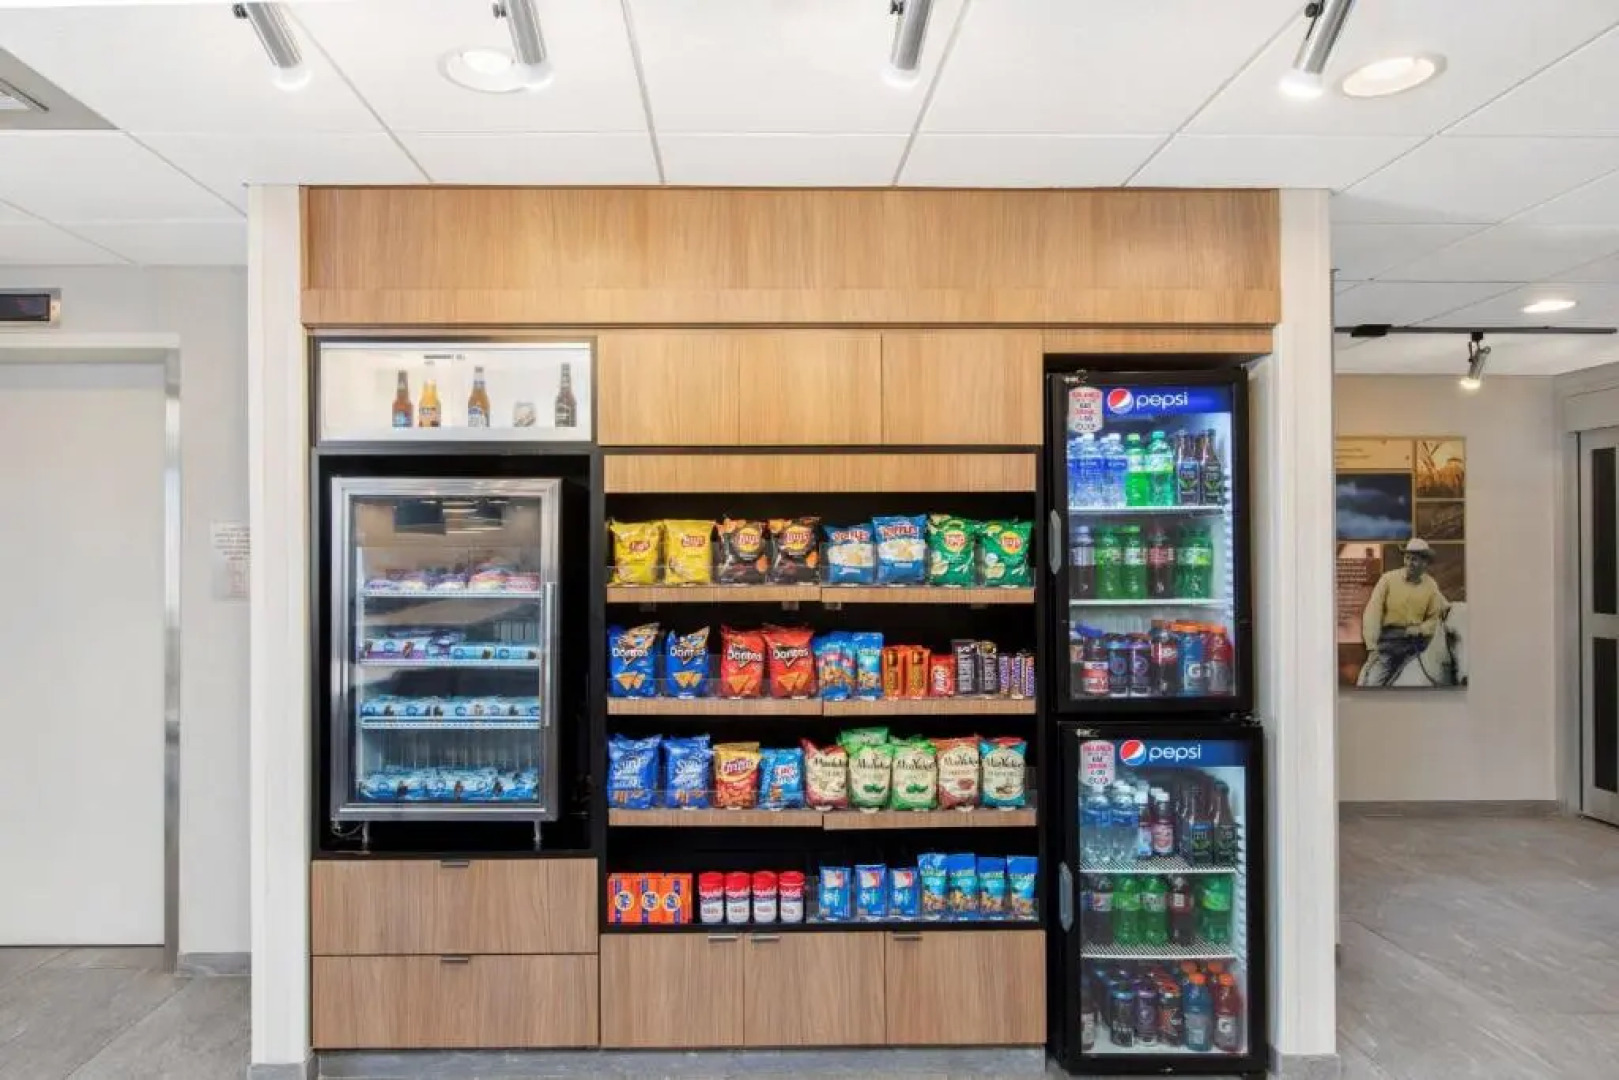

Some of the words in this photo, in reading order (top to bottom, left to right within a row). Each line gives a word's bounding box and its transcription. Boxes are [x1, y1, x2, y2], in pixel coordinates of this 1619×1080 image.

[1136, 391, 1188, 409] pepsi
[772, 646, 809, 659] Doritos
[1148, 744, 1201, 763] pepsi
